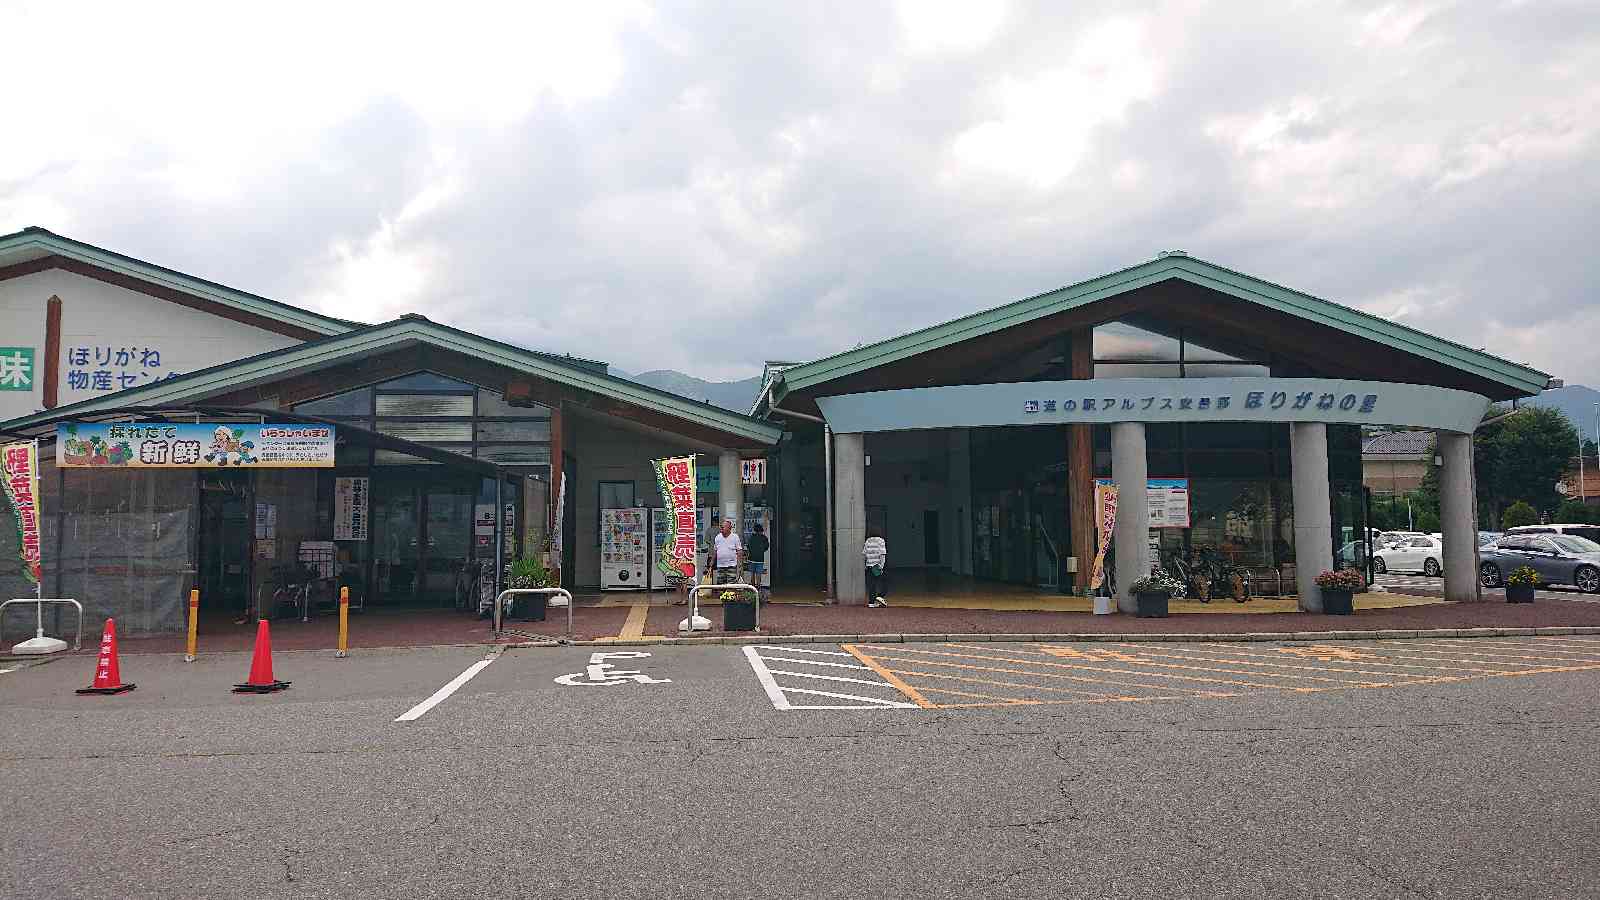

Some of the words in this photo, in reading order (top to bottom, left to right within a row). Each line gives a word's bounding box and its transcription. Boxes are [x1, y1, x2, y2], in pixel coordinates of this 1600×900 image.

[68, 347, 161, 367] ほりがね
[1244, 391, 1378, 412] ほりがねの里
[110, 425, 176, 438] 採れたて
[261, 429, 329, 438] いらっしゃいませ
[140, 440, 200, 464] 新鮮
